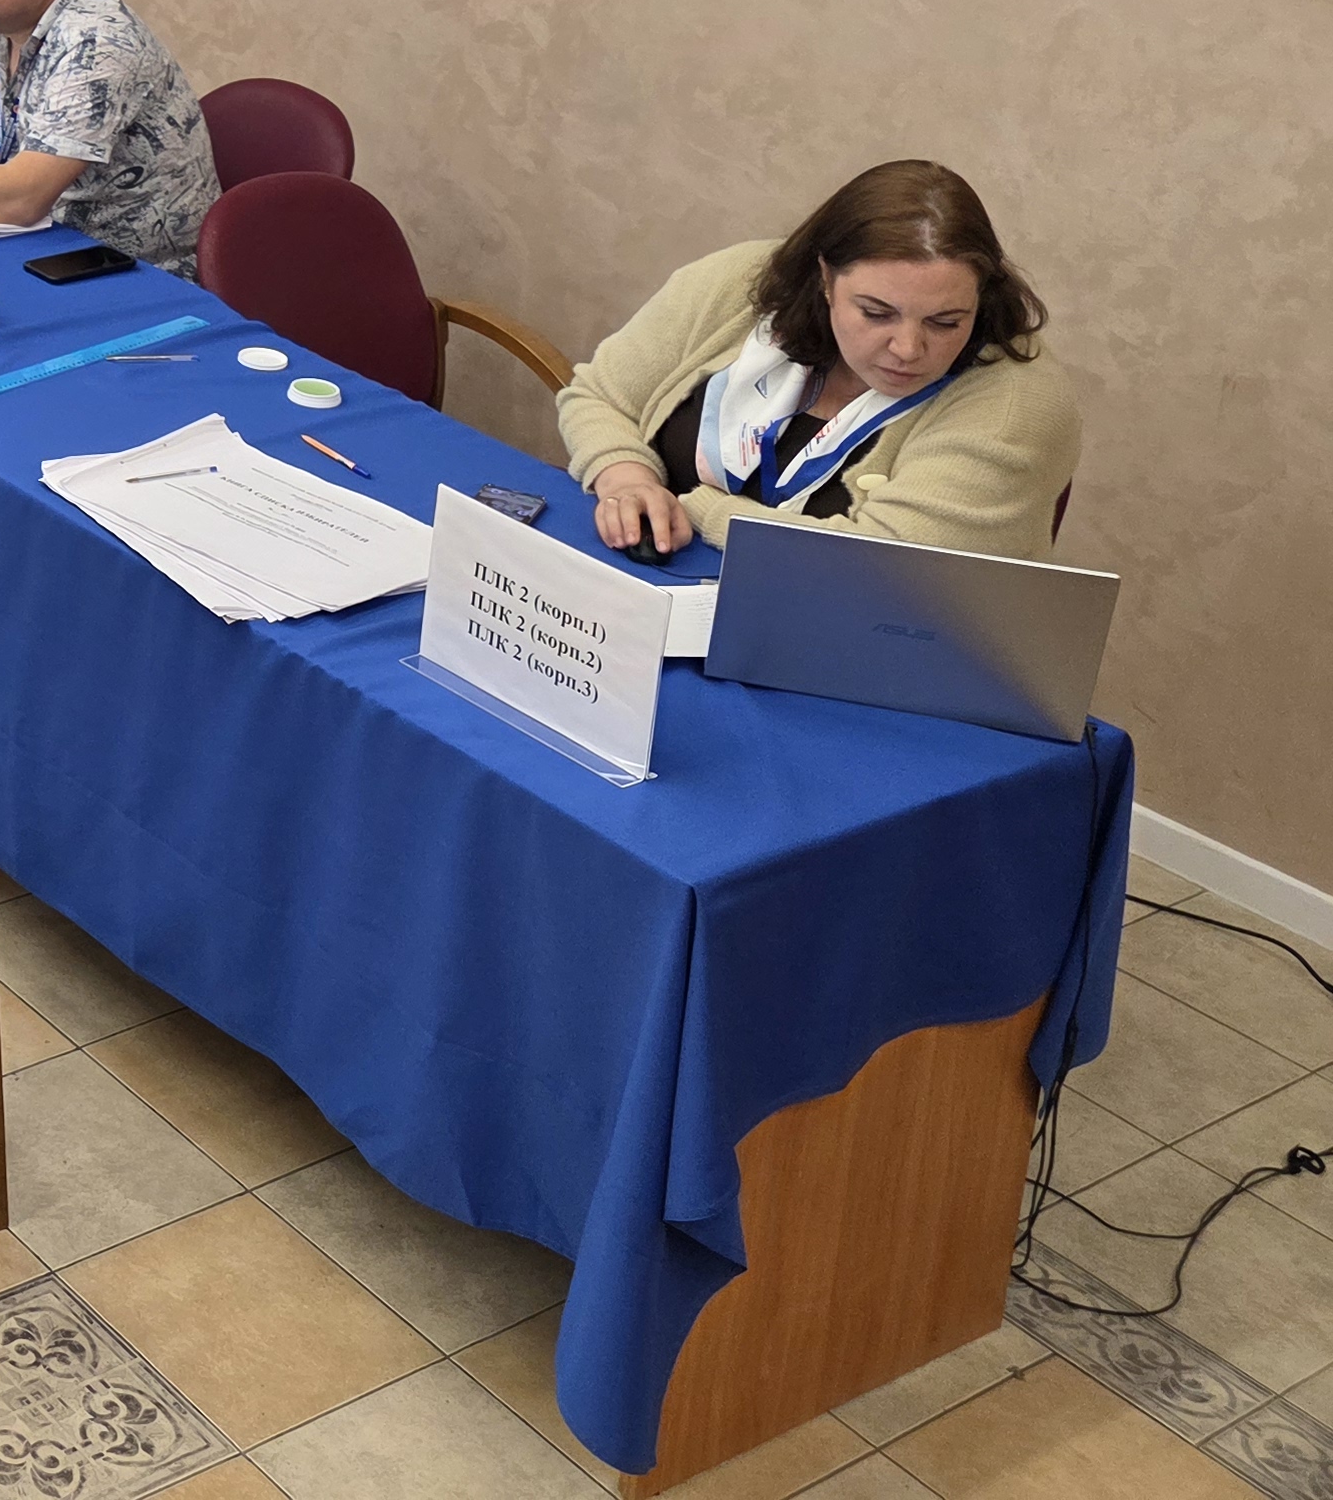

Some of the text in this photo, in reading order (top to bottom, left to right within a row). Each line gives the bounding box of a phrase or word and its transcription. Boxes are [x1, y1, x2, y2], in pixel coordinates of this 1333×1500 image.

[470, 589, 603, 674] ПЛК 2 (корп.2)
[473, 561, 607, 644] ПЛК 2 (корп.1)
[467, 618, 599, 704] ПЛК 2 (корп.3)
